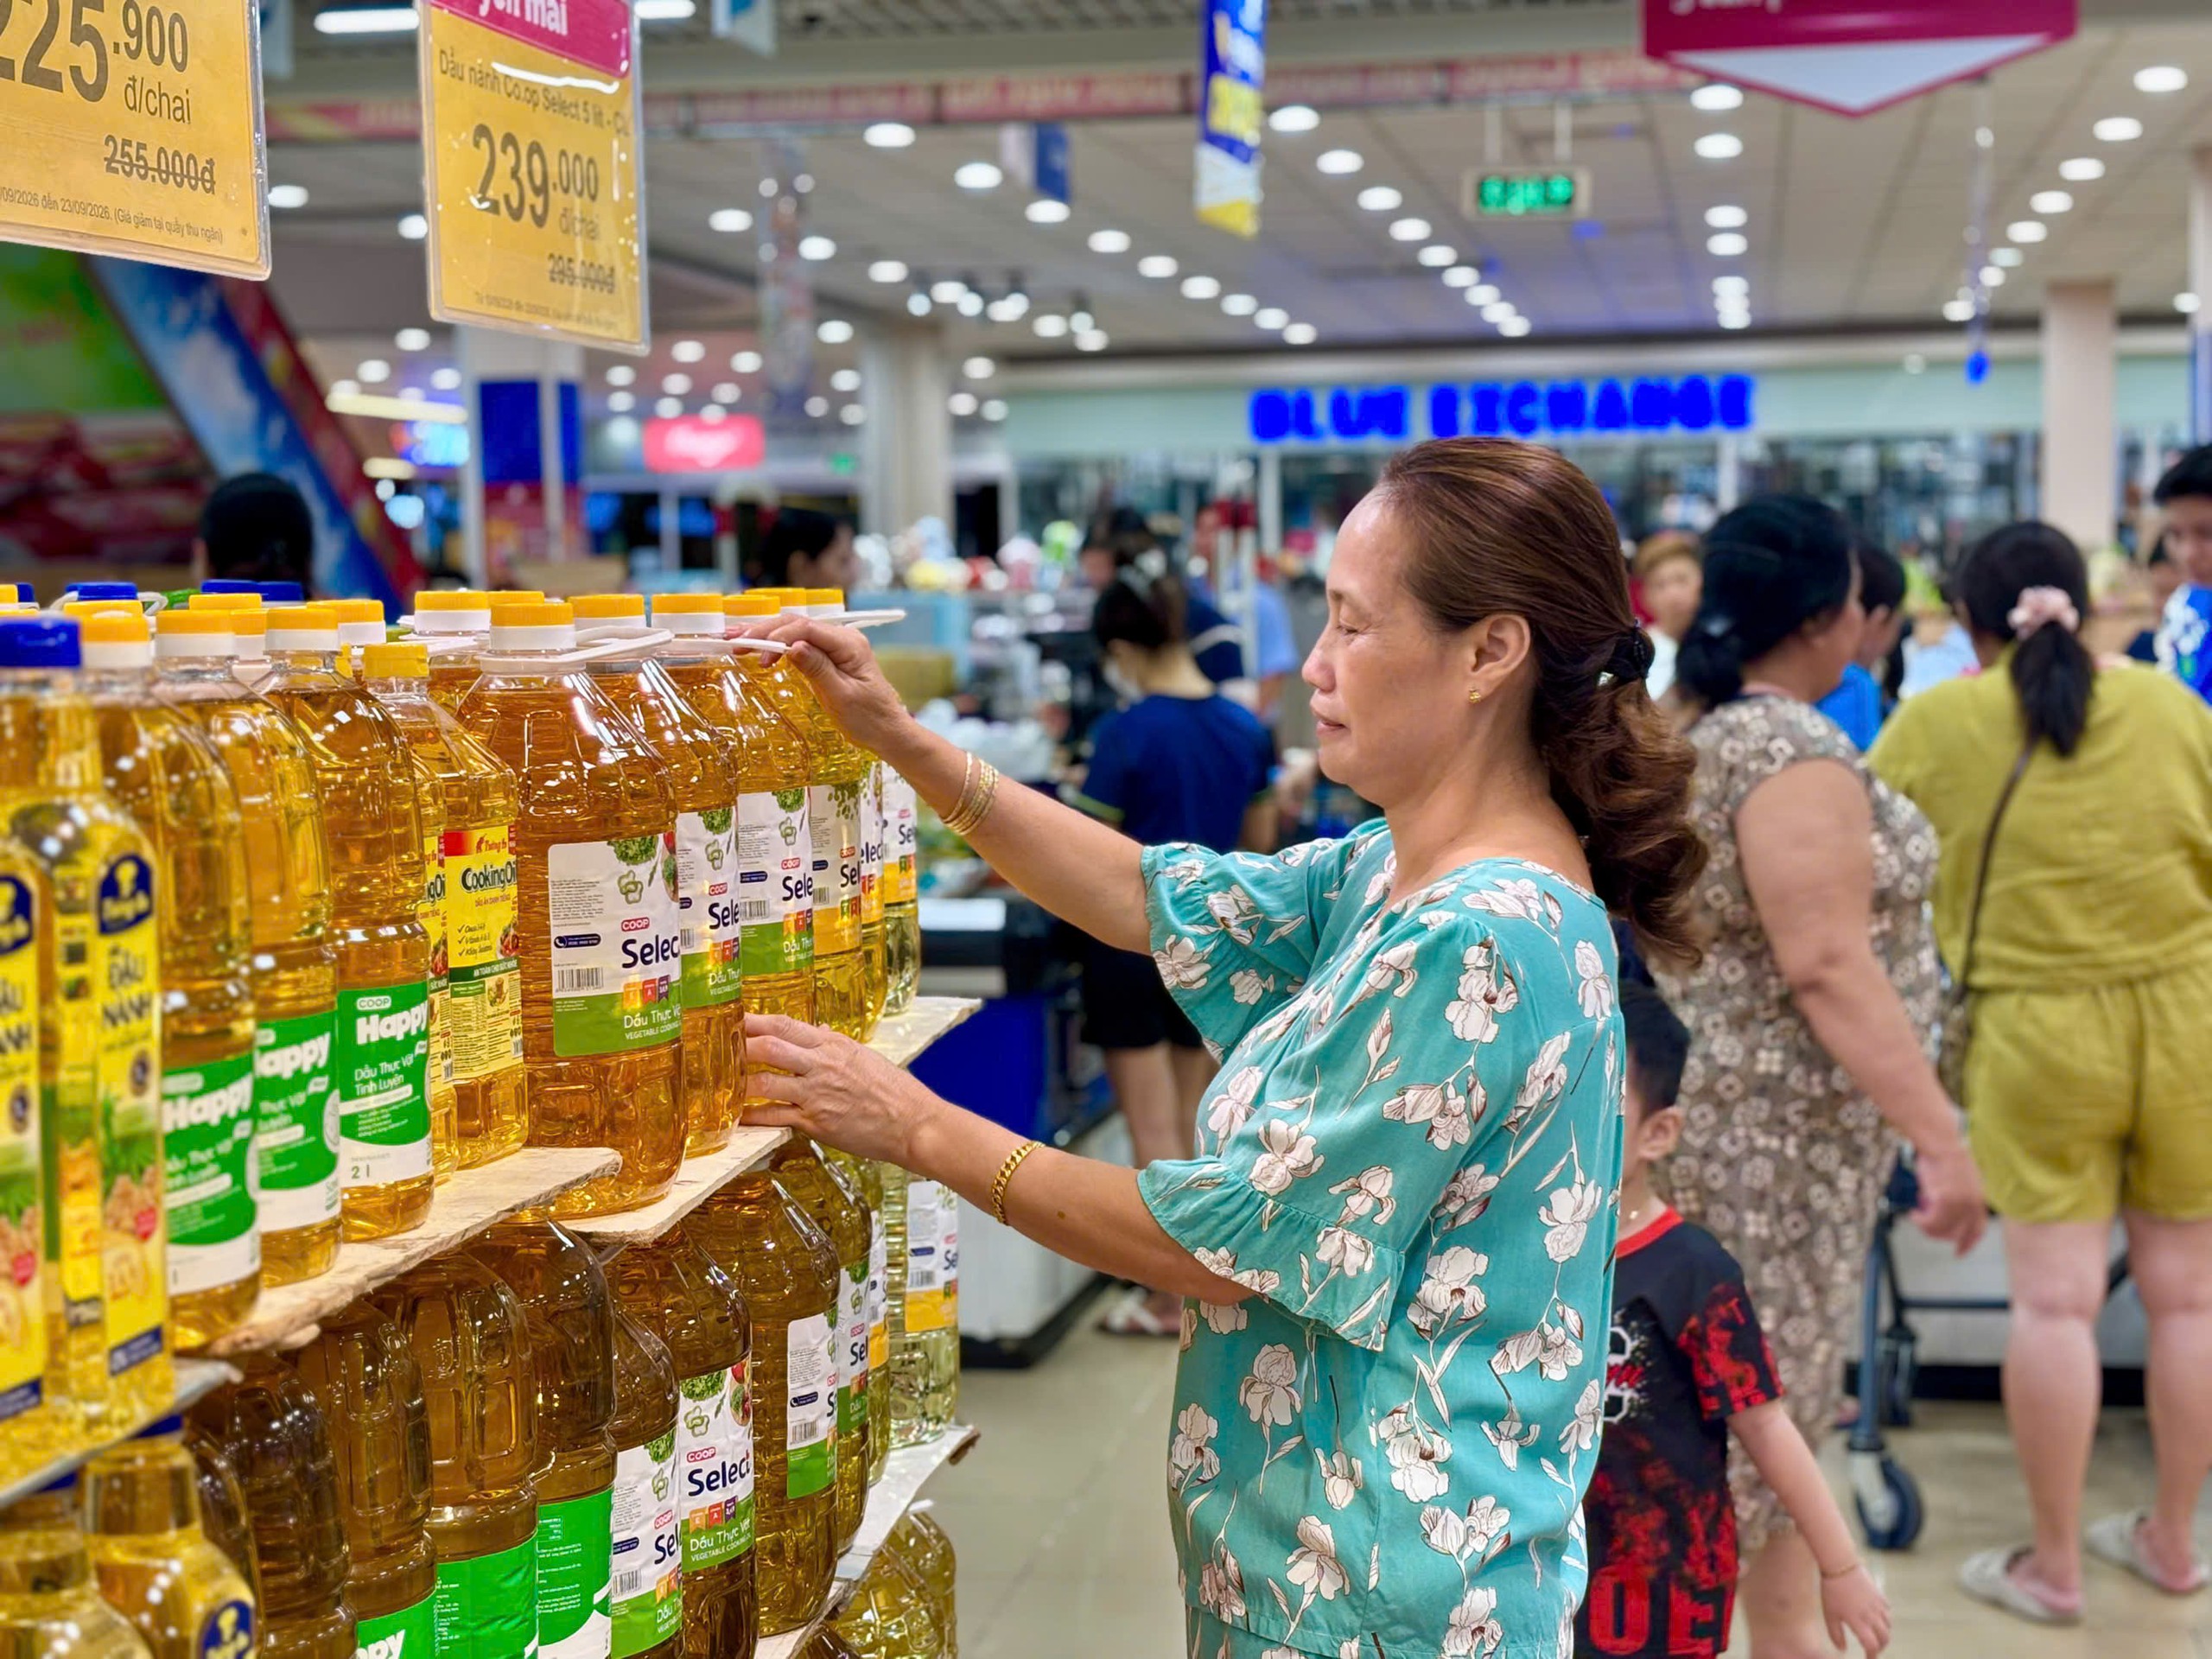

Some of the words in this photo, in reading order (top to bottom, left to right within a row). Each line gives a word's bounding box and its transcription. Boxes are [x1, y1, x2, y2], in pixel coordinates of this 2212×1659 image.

[124, 74, 191, 124] đ/chai
[104, 134, 215, 194] 255.000đ
[473, 124, 599, 228] 239.000
[622, 918, 649, 931] COOP
[359, 997, 390, 1009] COOP
[357, 1000, 428, 1046] Happy
[256, 1032, 331, 1079] appy
[354, 1064, 378, 1082] Dầu
[379, 1059, 401, 1074] Thực
[355, 1079, 378, 1096] Tinh
[378, 1073, 404, 1090] Luyện
[352, 1167, 360, 1179] 2
[688, 1447, 715, 1462] COOP
[688, 1452, 751, 1497] Select
[655, 1510, 672, 1529] COOP
[690, 1535, 714, 1551] Dầu
[716, 1527, 739, 1544] Thực
[691, 1545, 725, 1561] VEGETABLE
[657, 1604, 673, 1624] Dầu
